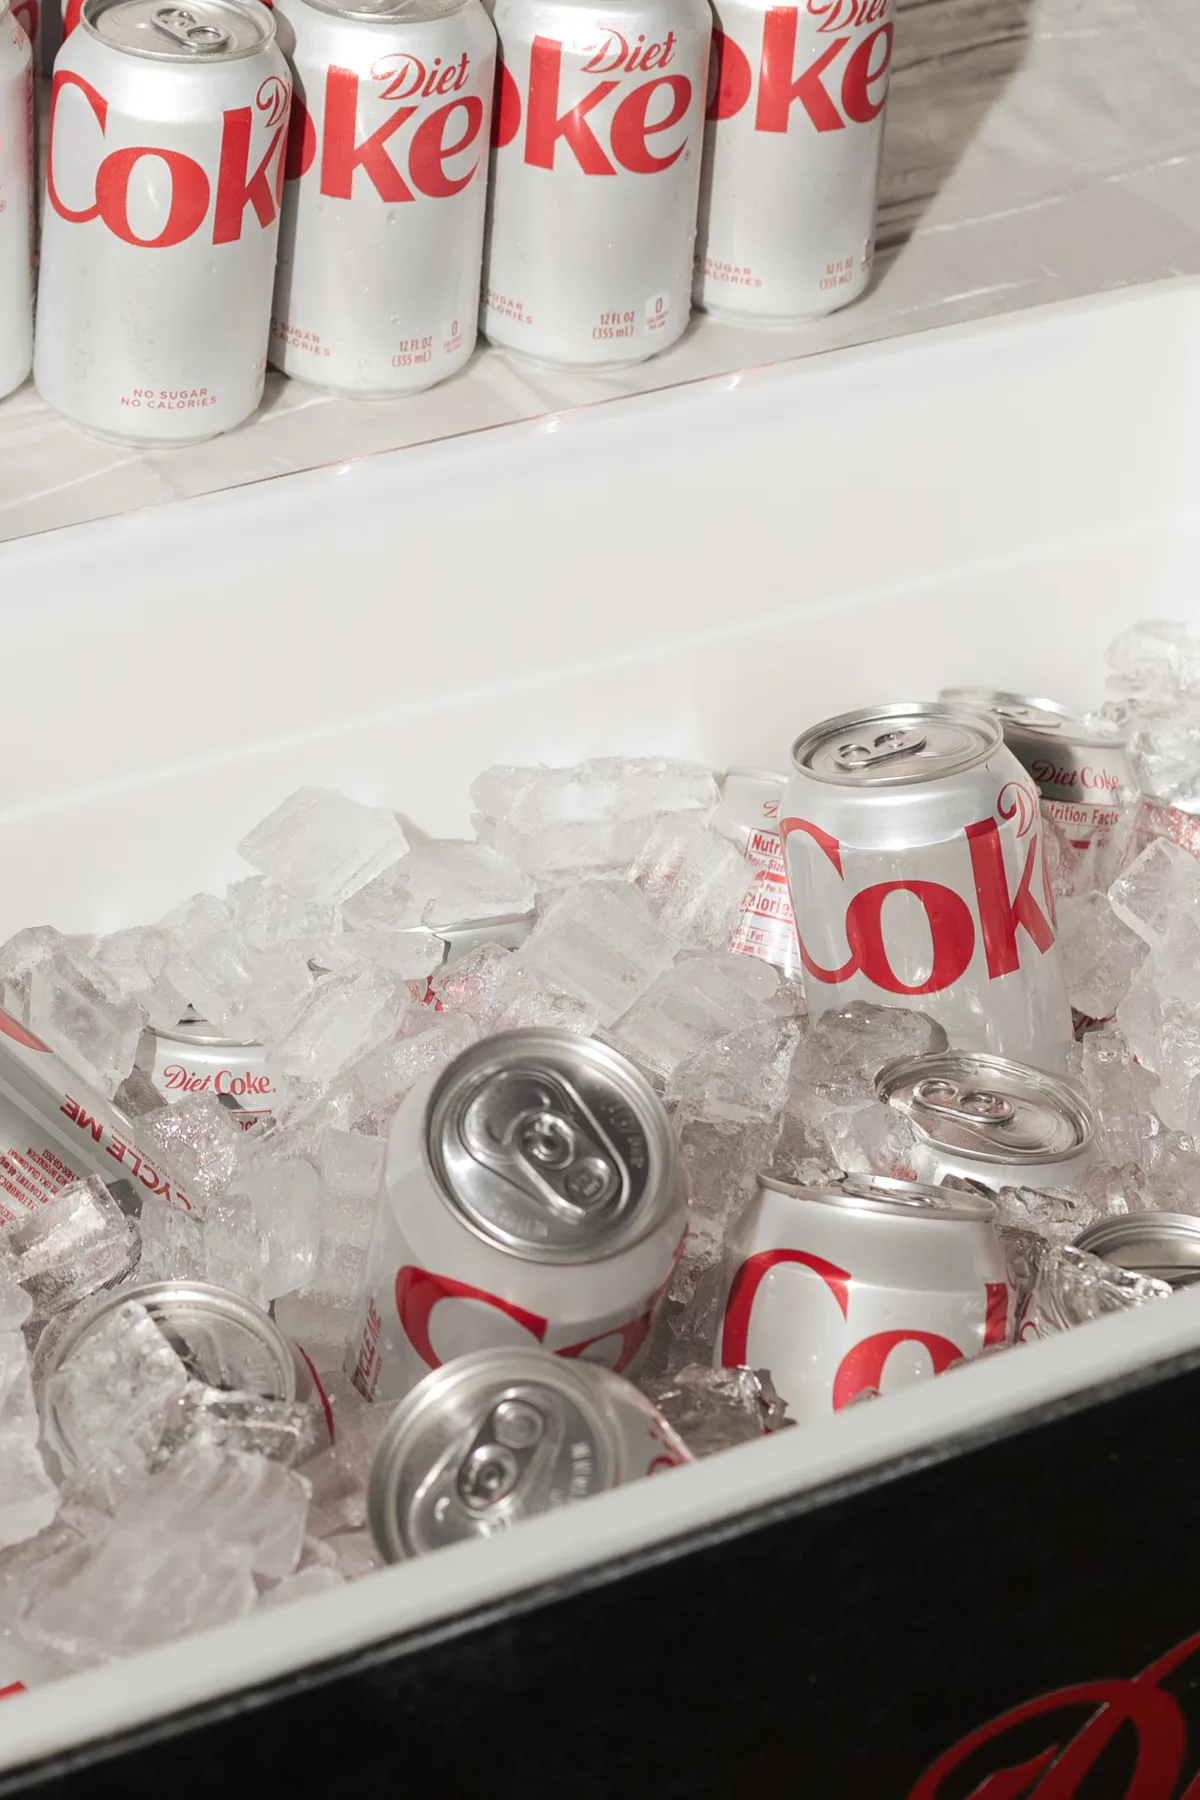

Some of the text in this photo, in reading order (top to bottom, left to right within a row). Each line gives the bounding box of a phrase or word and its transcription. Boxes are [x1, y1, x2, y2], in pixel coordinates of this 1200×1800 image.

[572, 27, 678, 74] Diet
[370, 51, 471, 101] Diet
[47, 69, 285, 249] Cok
[399, 340, 408, 351] 12
[411, 339, 419, 350] FL
[422, 336, 433, 349] OZ
[120, 395, 217, 410] NO CALORIES
[133, 388, 207, 400] NO SUGAR
[1031, 758, 1120, 791] Diet Coke
[1048, 803, 1120, 827] trition Facts
[779, 816, 1057, 995] Cok
[163, 1064, 272, 1097] Diet Coke
[58, 1093, 111, 1141] ME
